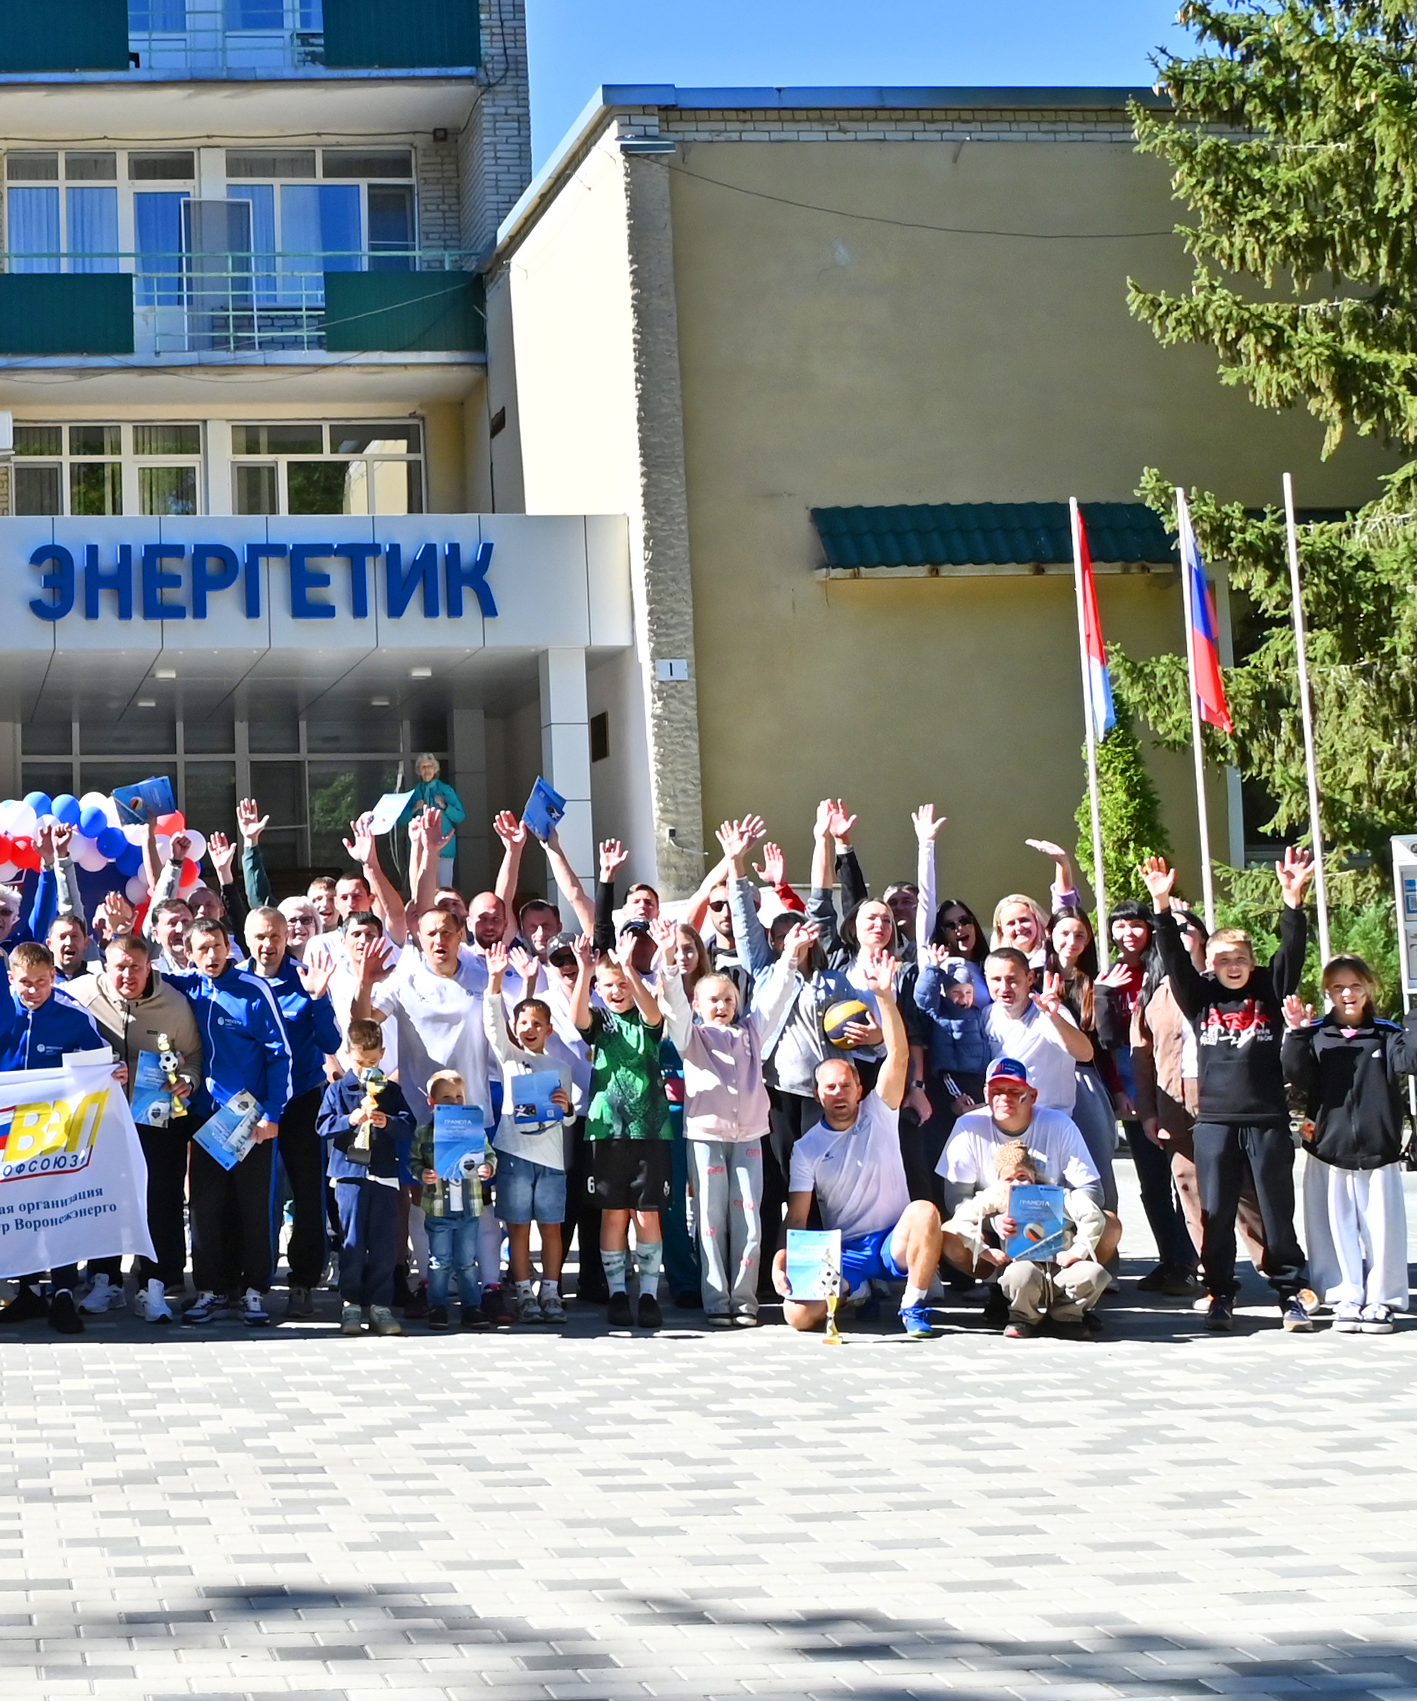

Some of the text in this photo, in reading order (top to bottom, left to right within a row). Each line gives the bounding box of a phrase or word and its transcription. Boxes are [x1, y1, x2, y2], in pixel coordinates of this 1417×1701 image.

[28, 542, 499, 621] ЭНЕРГЕТИК
[587, 1176, 596, 1194] 6
[15, 1202, 117, 1231] Воронежэнерго
[19, 1187, 104, 1219] организация
